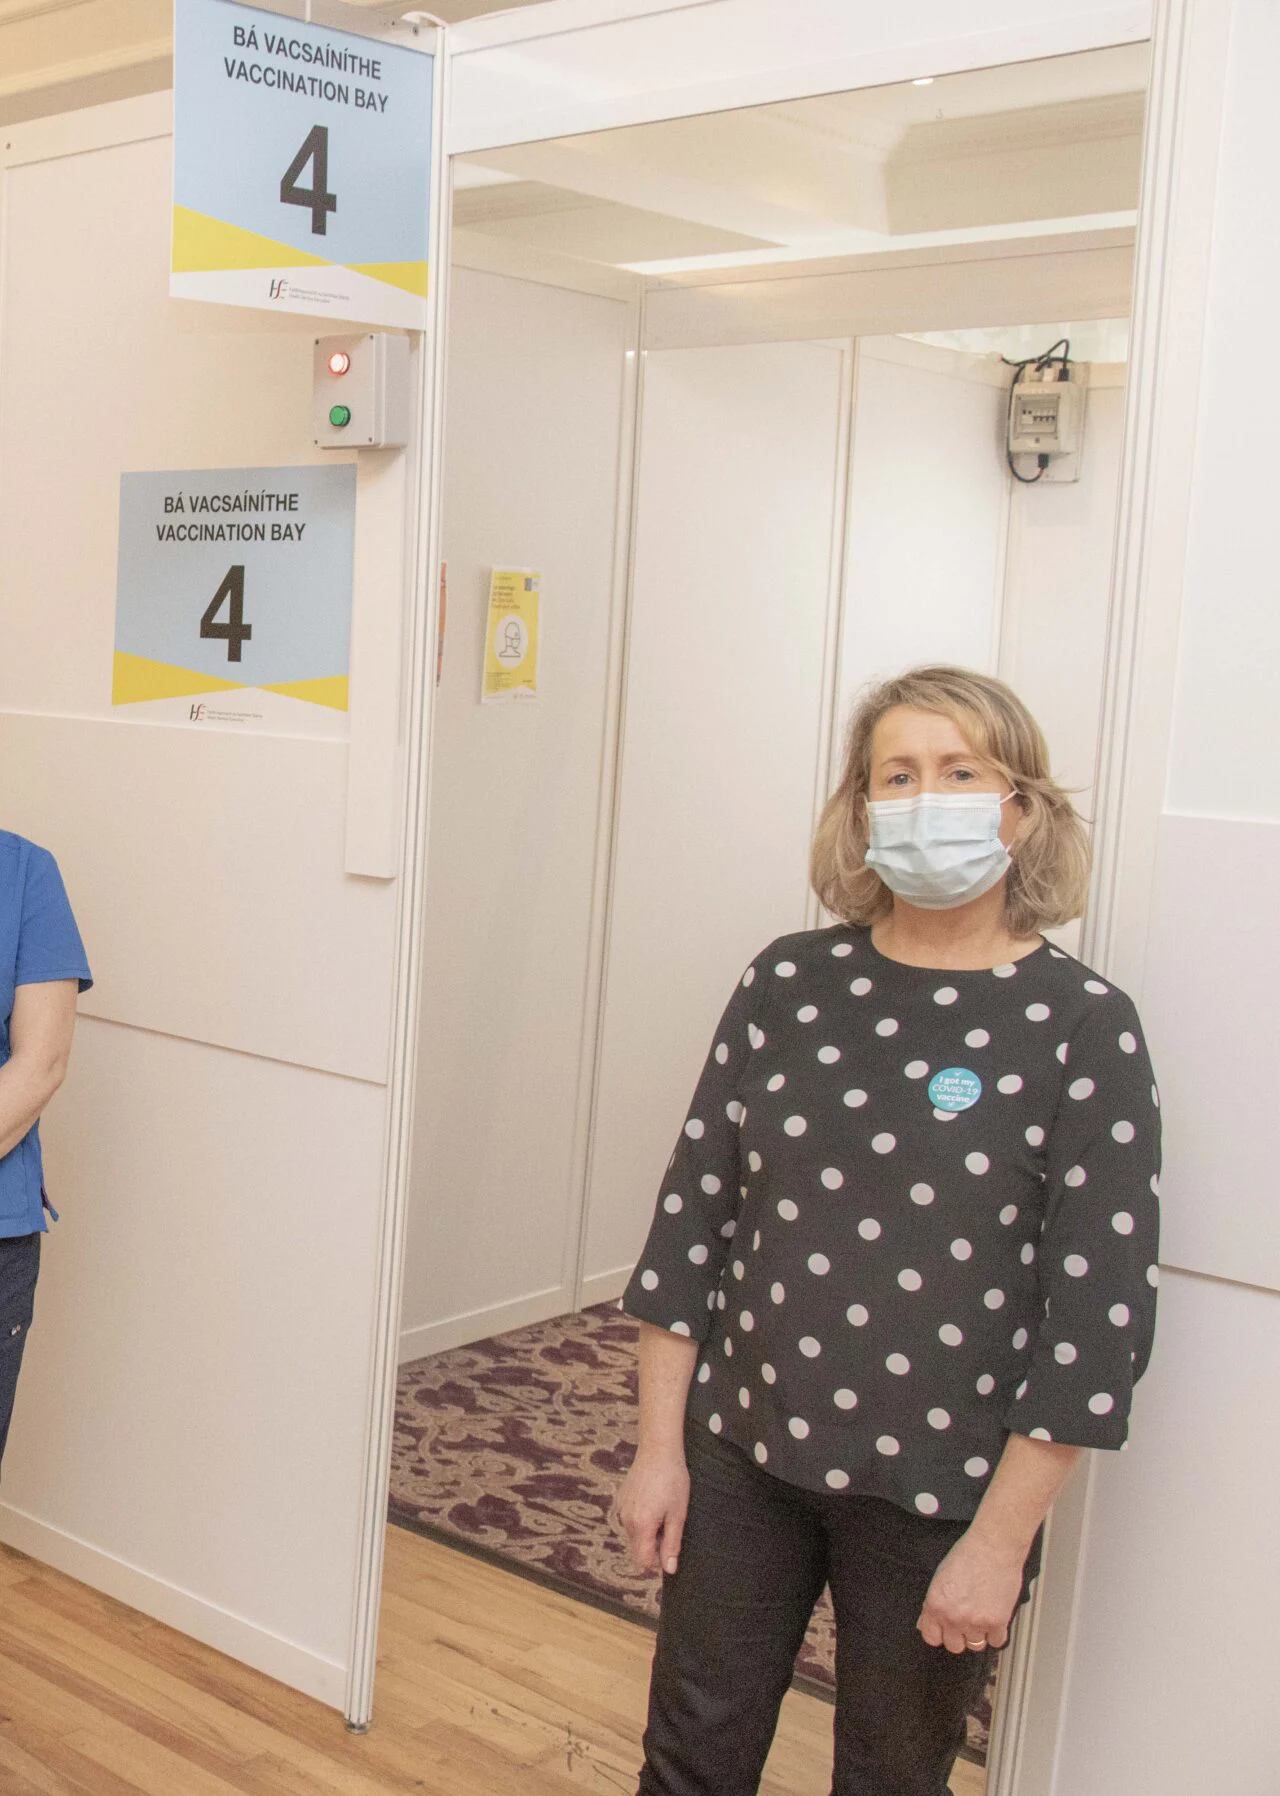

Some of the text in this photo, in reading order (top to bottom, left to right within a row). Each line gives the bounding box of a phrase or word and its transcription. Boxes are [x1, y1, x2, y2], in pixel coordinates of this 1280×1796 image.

[233, 25, 382, 80] BÁ VACSAÍNÍTHE
[224, 57, 388, 113] VACCINATION BAY
[280, 124, 337, 236] 4
[163, 489, 299, 514] BÁ VACSAÍNÍTHE
[156, 523, 306, 542] VACCINATION BAY
[200, 565, 252, 662] 4
[932, 1083, 978, 1095] COVID-19
[961, 1079, 976, 1087] my
[936, 1094, 971, 1103] vaccine
